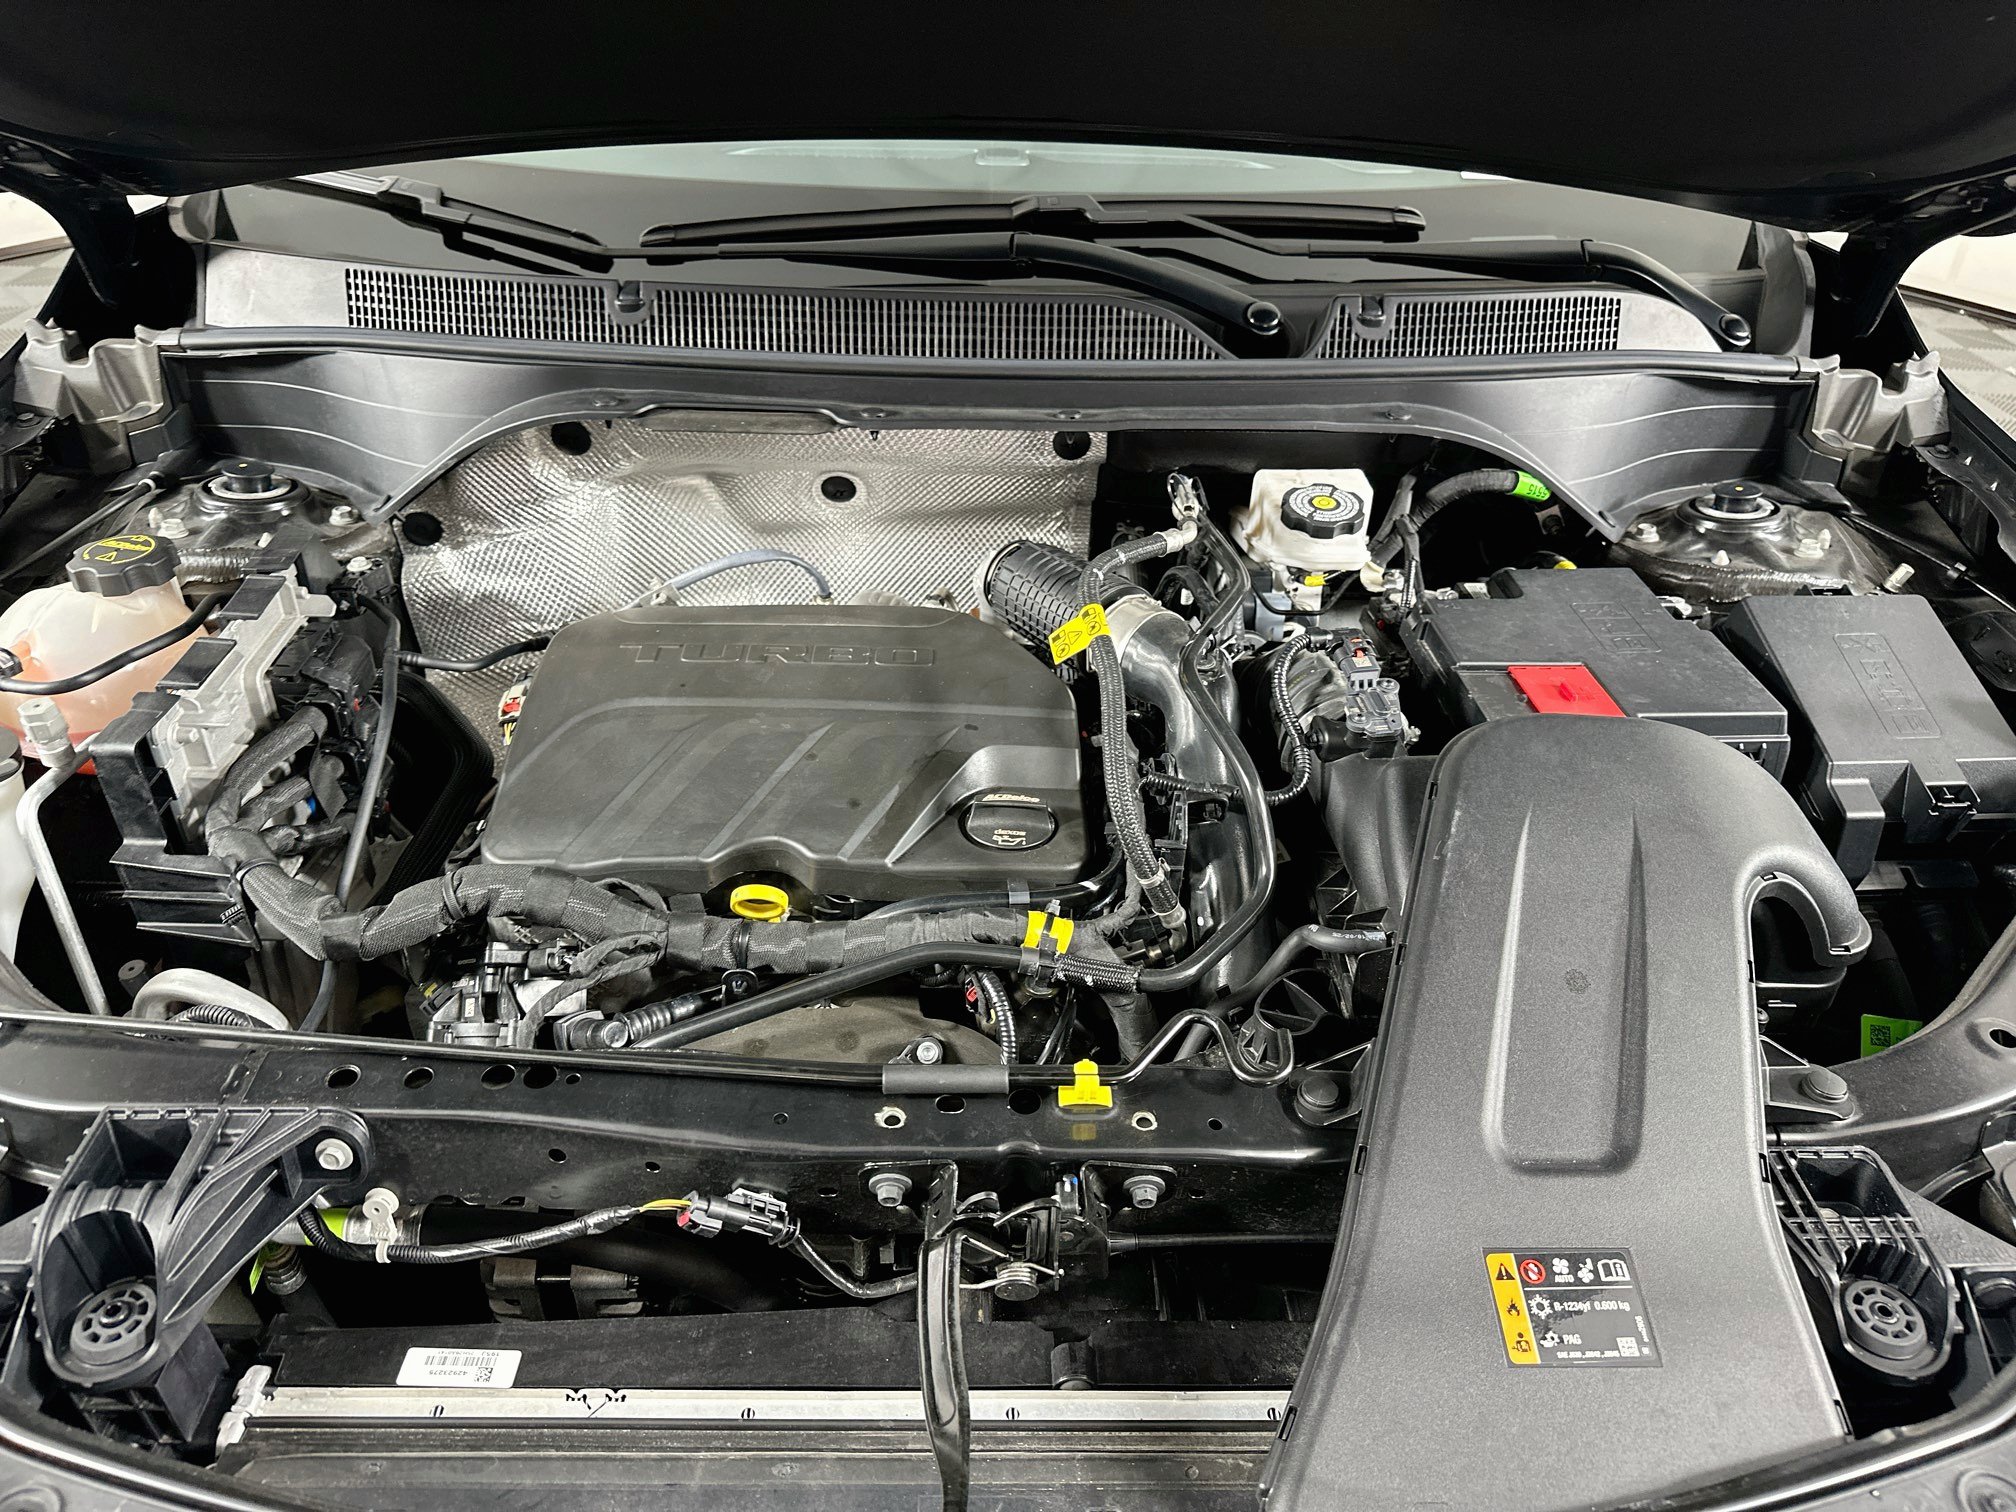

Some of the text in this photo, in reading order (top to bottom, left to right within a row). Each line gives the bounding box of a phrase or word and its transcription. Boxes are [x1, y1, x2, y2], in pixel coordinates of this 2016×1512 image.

[619, 643, 935, 667] TURBO
[1554, 1274, 1575, 1283] AUTO
[1553, 1300, 1631, 1313] R-1234yf 0.600 kg
[1562, 1333, 1582, 1345] PAG
